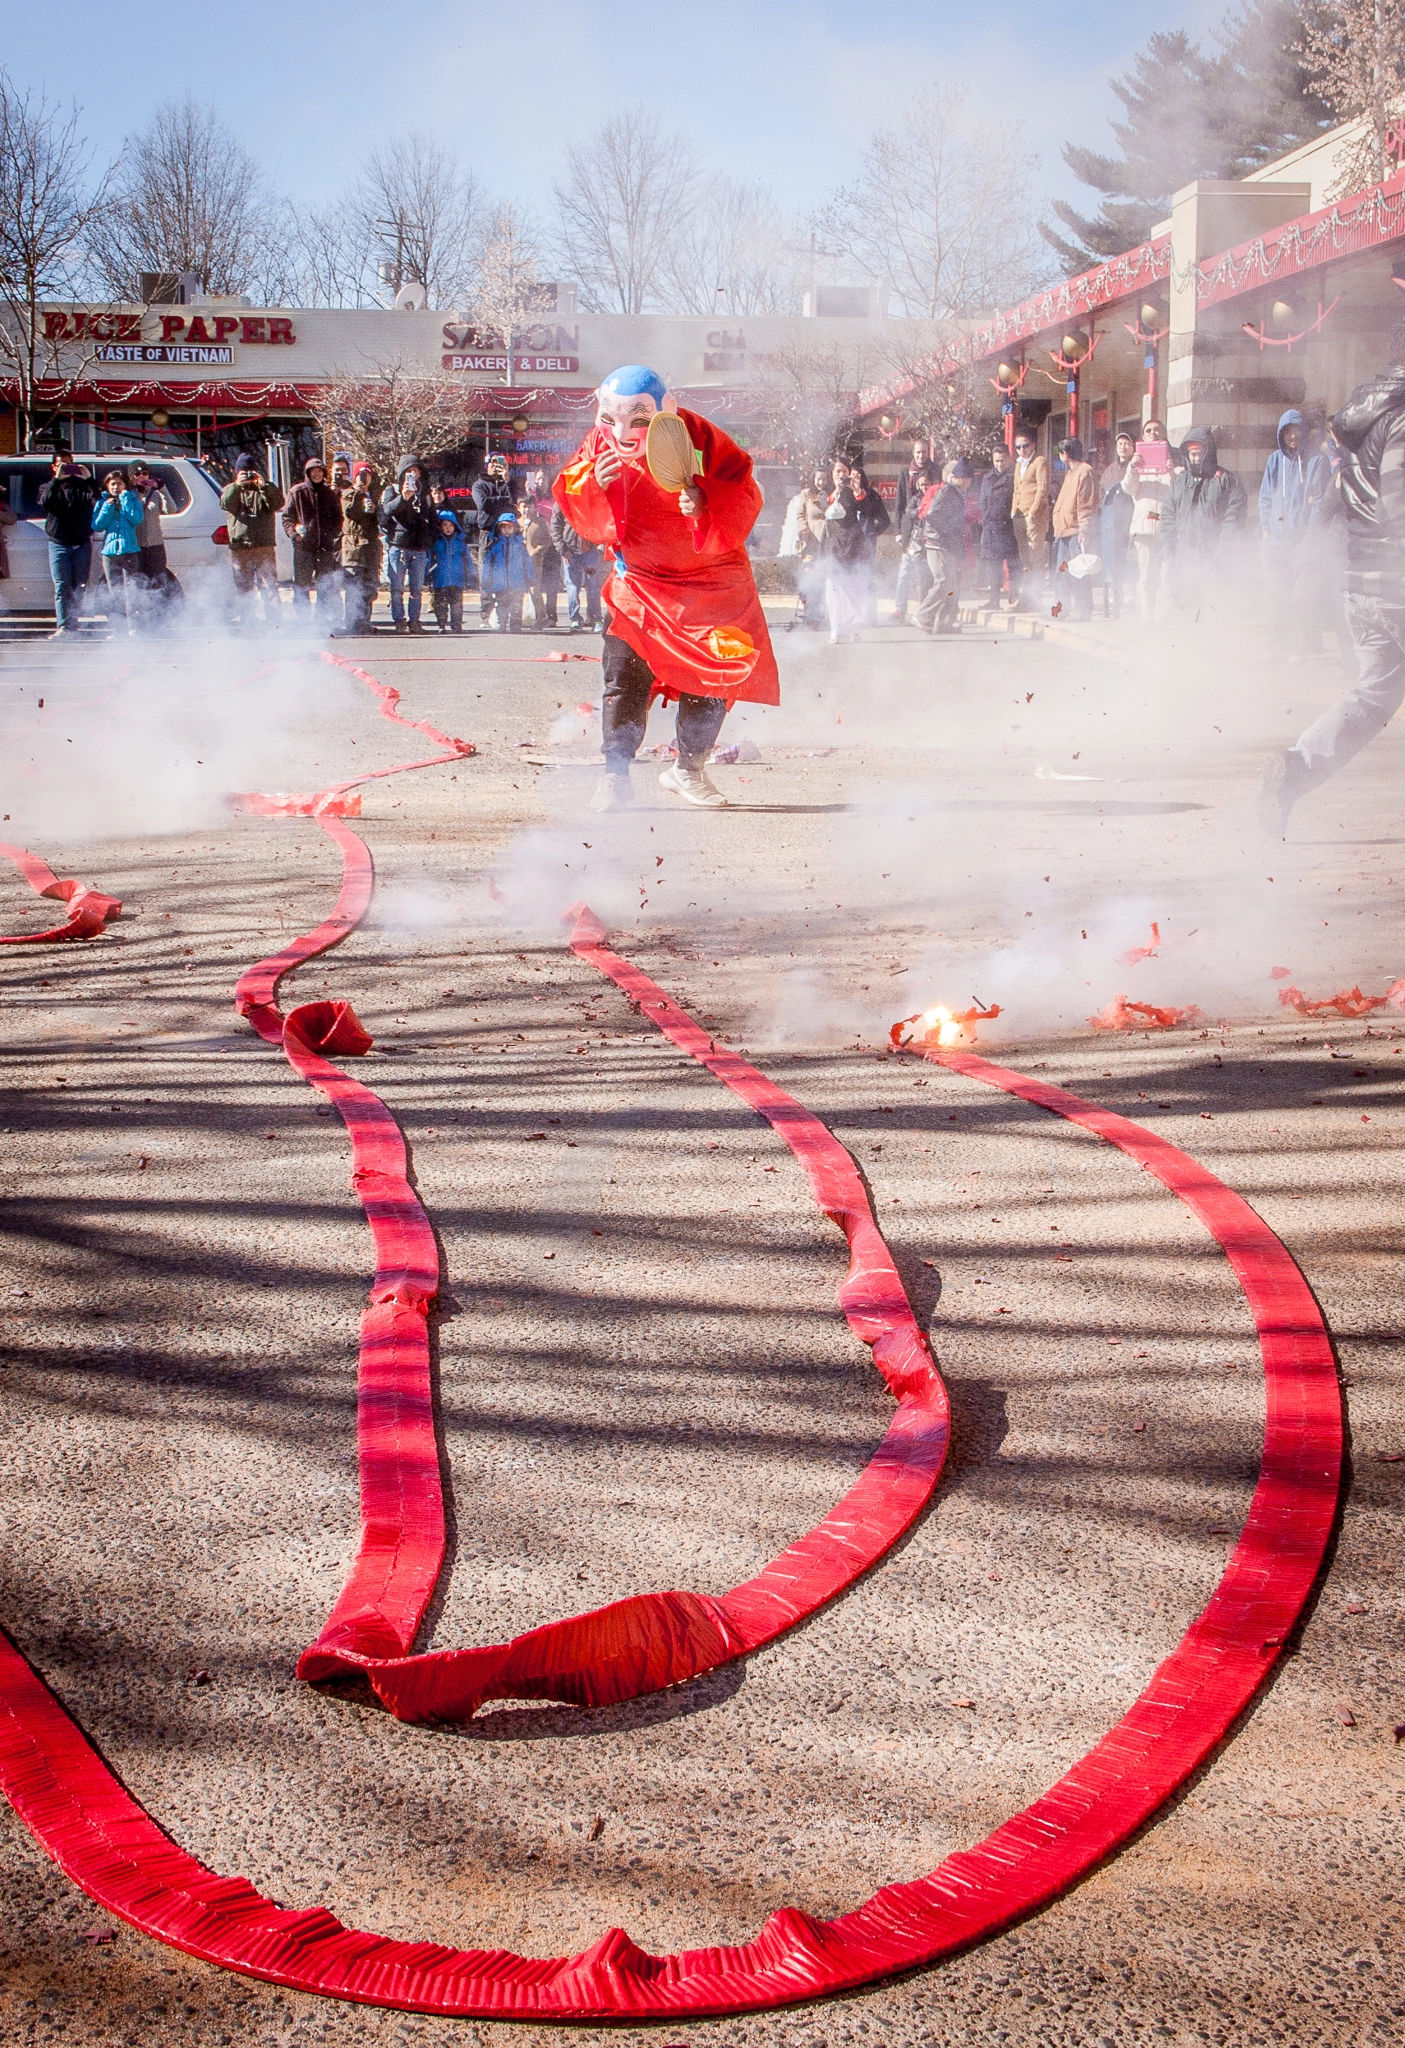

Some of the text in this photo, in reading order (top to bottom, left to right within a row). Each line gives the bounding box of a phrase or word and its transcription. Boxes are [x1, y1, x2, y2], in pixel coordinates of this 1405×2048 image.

[42, 311, 296, 344] RICE PAPER
[98, 345, 231, 363] TASTE OF VIETNAM
[452, 356, 570, 371] BAKER & DELI
[560, 442, 576, 453] DEL
